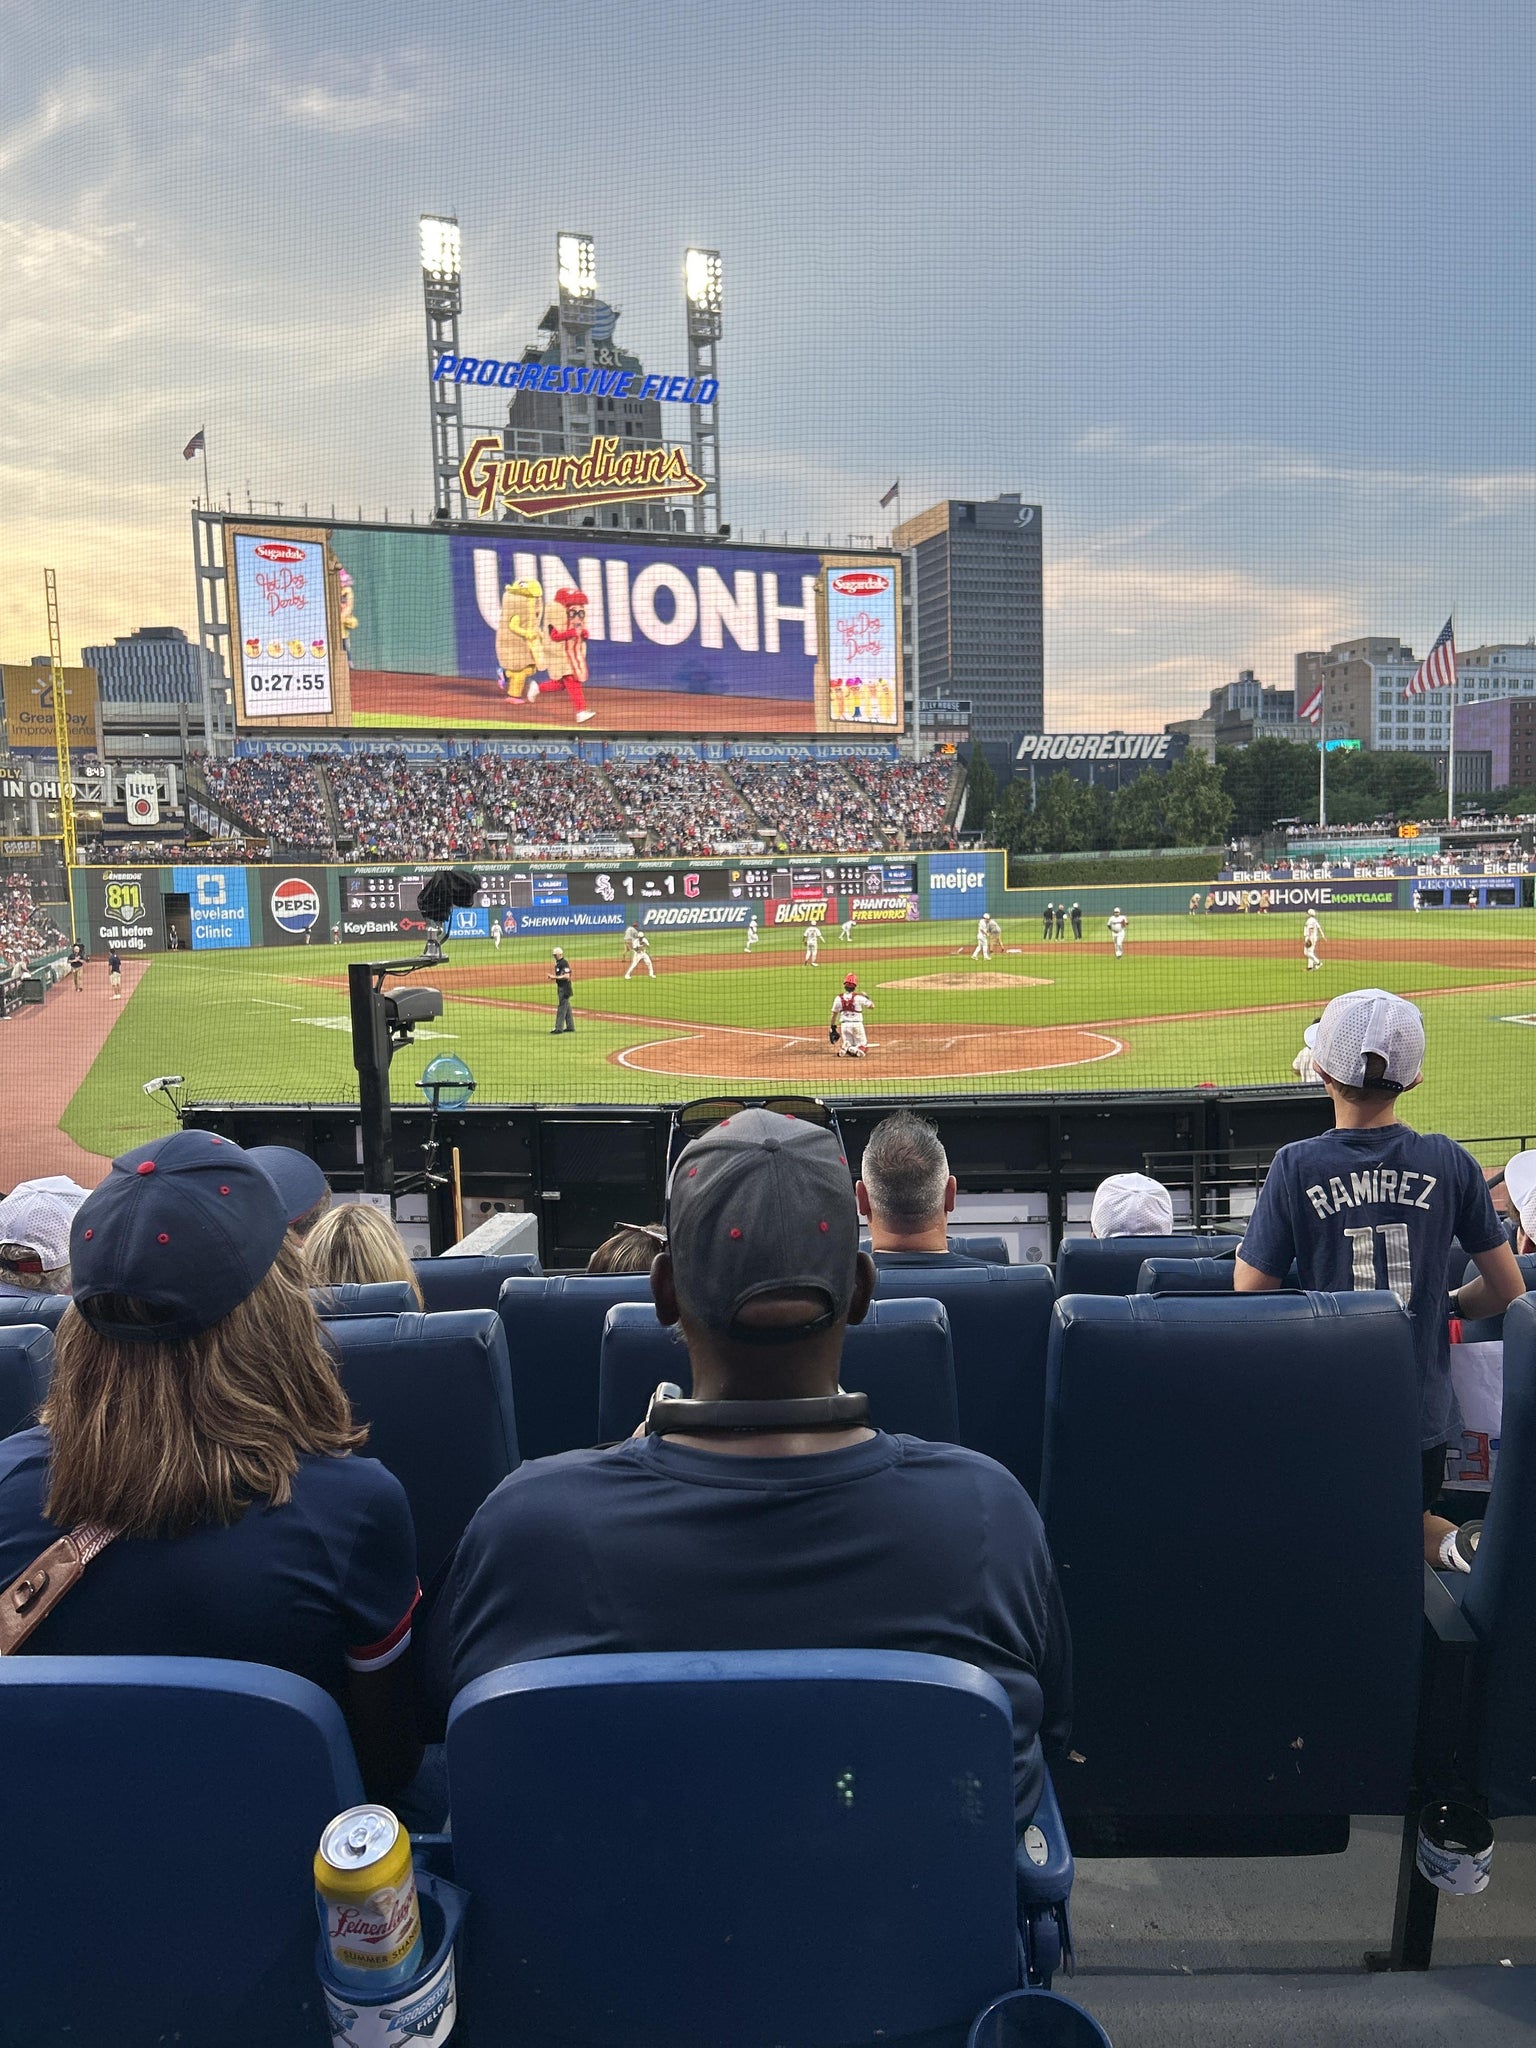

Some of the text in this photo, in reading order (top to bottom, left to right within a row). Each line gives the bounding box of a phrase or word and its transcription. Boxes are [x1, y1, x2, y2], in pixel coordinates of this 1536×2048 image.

[432, 355, 720, 405] PROGRESSIVE FIELD
[459, 434, 707, 517] Guardians
[1014, 507, 1035, 528] 9
[256, 545, 305, 561] Sugardale
[255, 567, 309, 599] Hot Dog
[833, 576, 888, 593] Sugardale
[267, 589, 309, 617] Derby
[250, 673, 325, 692] 0:27:55
[264, 742, 345, 753] HONDA
[369, 742, 446, 754] HONDA
[502, 744, 574, 755] HONDA
[628, 744, 696, 756] HONDA
[748, 745, 811, 756] HONDA
[830, 745, 892, 757] HONDA
[1016, 735, 1172, 760] PROGRESSIVE
[3, 780, 77, 799] IN OHIO
[130, 783, 155, 798] Lite
[622, 876, 634, 896] 1
[664, 873, 700, 898] 1 C
[930, 868, 985, 892] meijer
[108, 884, 140, 908] 811
[852, 898, 907, 910] PHANTOM
[1331, 892, 1393, 904] MORTGAGE
[190, 906, 245, 920] leveland
[275, 900, 317, 912] PEPSI
[775, 903, 828, 923] BLASTER
[852, 909, 906, 920] FIREWORKS
[643, 906, 748, 926] PROGRESSIVE
[100, 925, 153, 938] Call before
[196, 924, 232, 938] Clinic
[344, 920, 399, 935] KeyBank
[1306, 1162, 1437, 1220] RAMÍREZ
[1343, 1222, 1412, 1309] 11
[343, 1950, 388, 1963] SUMMER
[416, 2003, 444, 2032] FIELD
